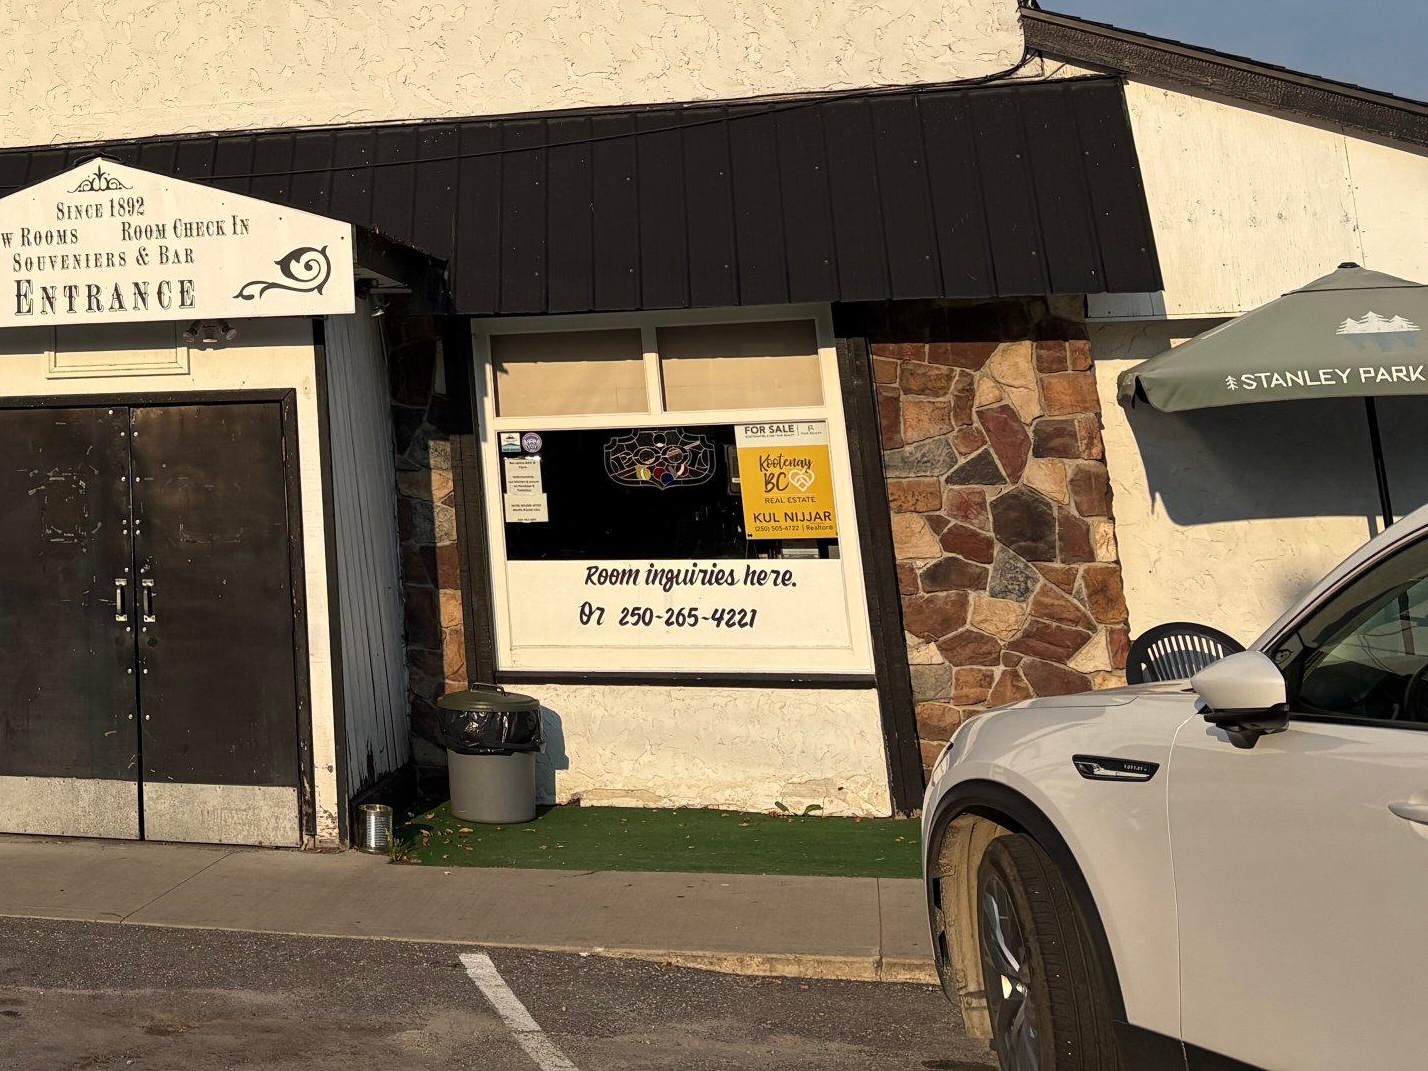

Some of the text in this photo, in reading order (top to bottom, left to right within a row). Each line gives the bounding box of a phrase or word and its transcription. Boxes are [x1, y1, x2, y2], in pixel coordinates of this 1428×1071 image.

[108, 196, 145, 217] 1892
[135, 246, 150, 266] &
[14, 279, 196, 316] ENTRANCE
[1240, 365, 1426, 390] STANLEY PARK
[744, 425, 766, 434] FOR
[768, 424, 795, 434] SALE
[759, 453, 812, 474] Kootenay
[764, 472, 789, 493] BC
[787, 496, 817, 504] ESTATE
[753, 511, 832, 523] KUL NIJJAR
[584, 565, 640, 586] Room
[743, 564, 797, 587] here.
[579, 601, 758, 629] Or 250-265-4221
